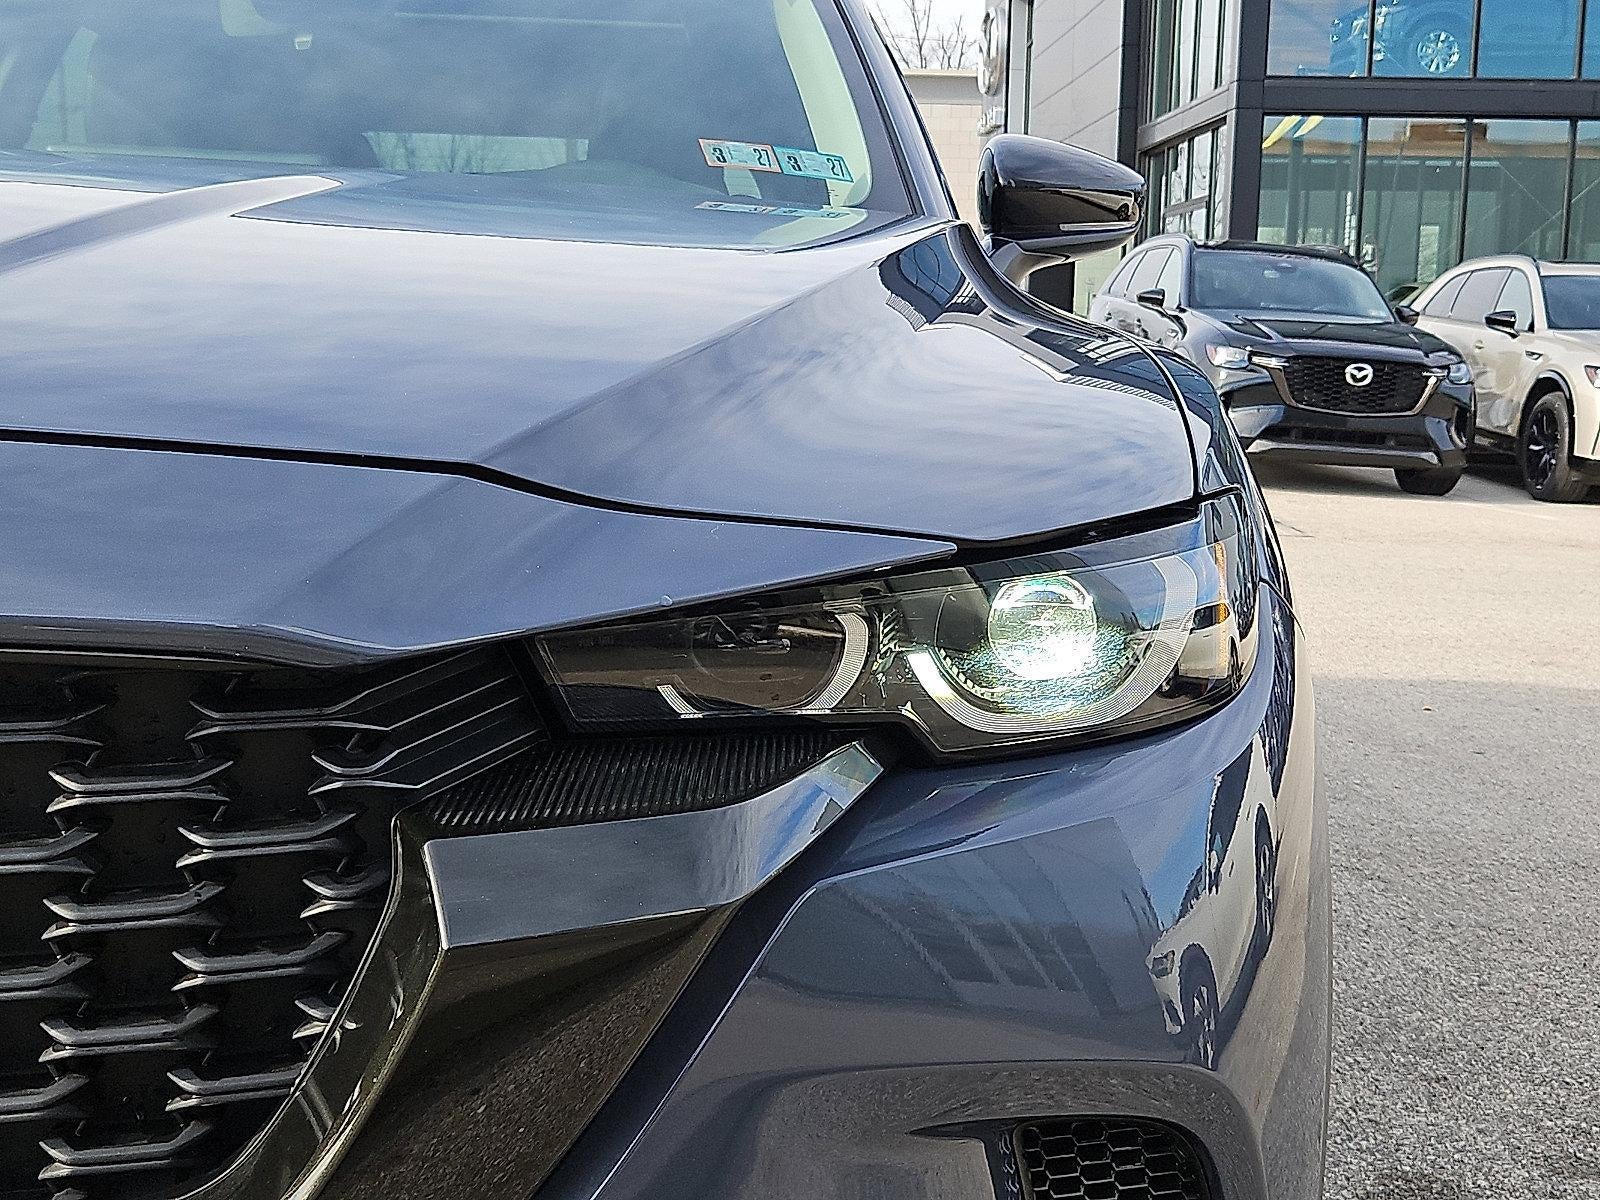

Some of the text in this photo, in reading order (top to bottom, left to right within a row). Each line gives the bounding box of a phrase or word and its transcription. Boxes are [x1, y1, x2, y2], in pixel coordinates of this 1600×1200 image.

[712, 147, 727, 163] 3
[753, 148, 771, 168] 27
[787, 155, 802, 171] 3
[826, 157, 845, 178] 27
